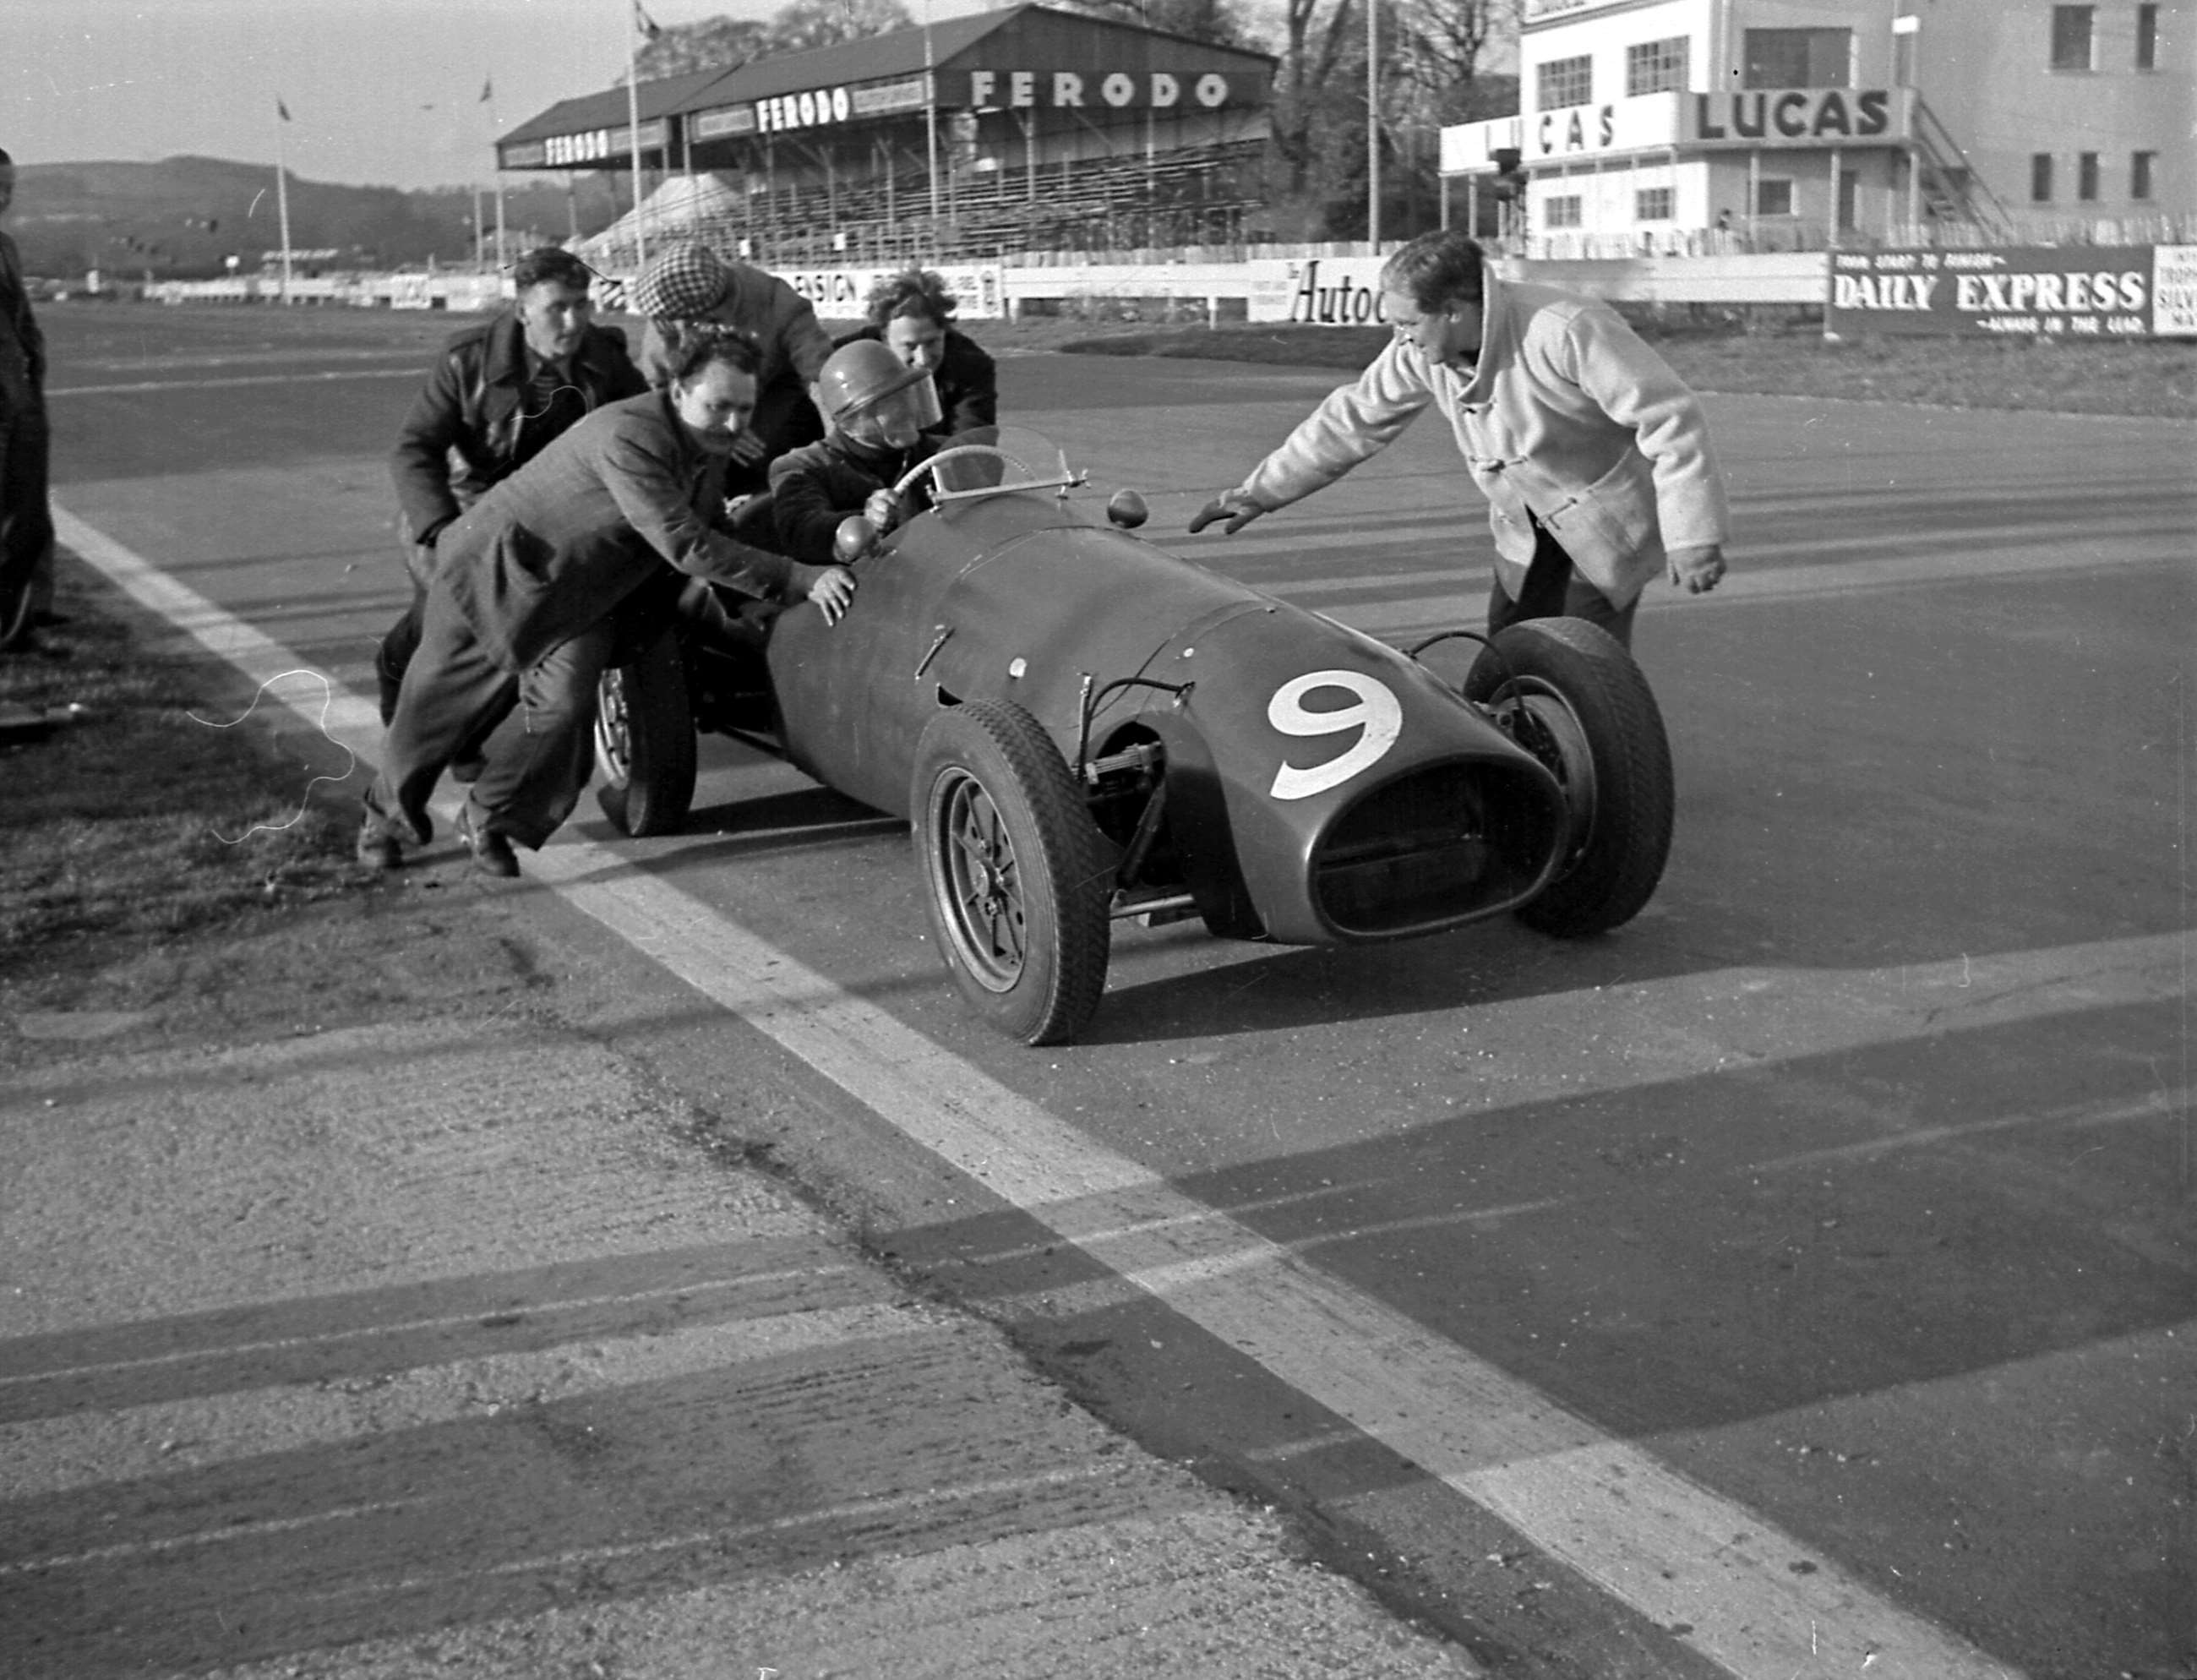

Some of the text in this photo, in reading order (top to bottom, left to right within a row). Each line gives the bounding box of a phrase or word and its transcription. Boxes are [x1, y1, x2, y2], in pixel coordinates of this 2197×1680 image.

[755, 86, 850, 133] FERODO
[971, 70, 1229, 107] FERODO
[1695, 91, 1889, 139] LUCAS
[1834, 275, 1938, 311] DAILY
[1956, 271, 2146, 311] EXPRESS
[1268, 669, 1403, 799] 9
